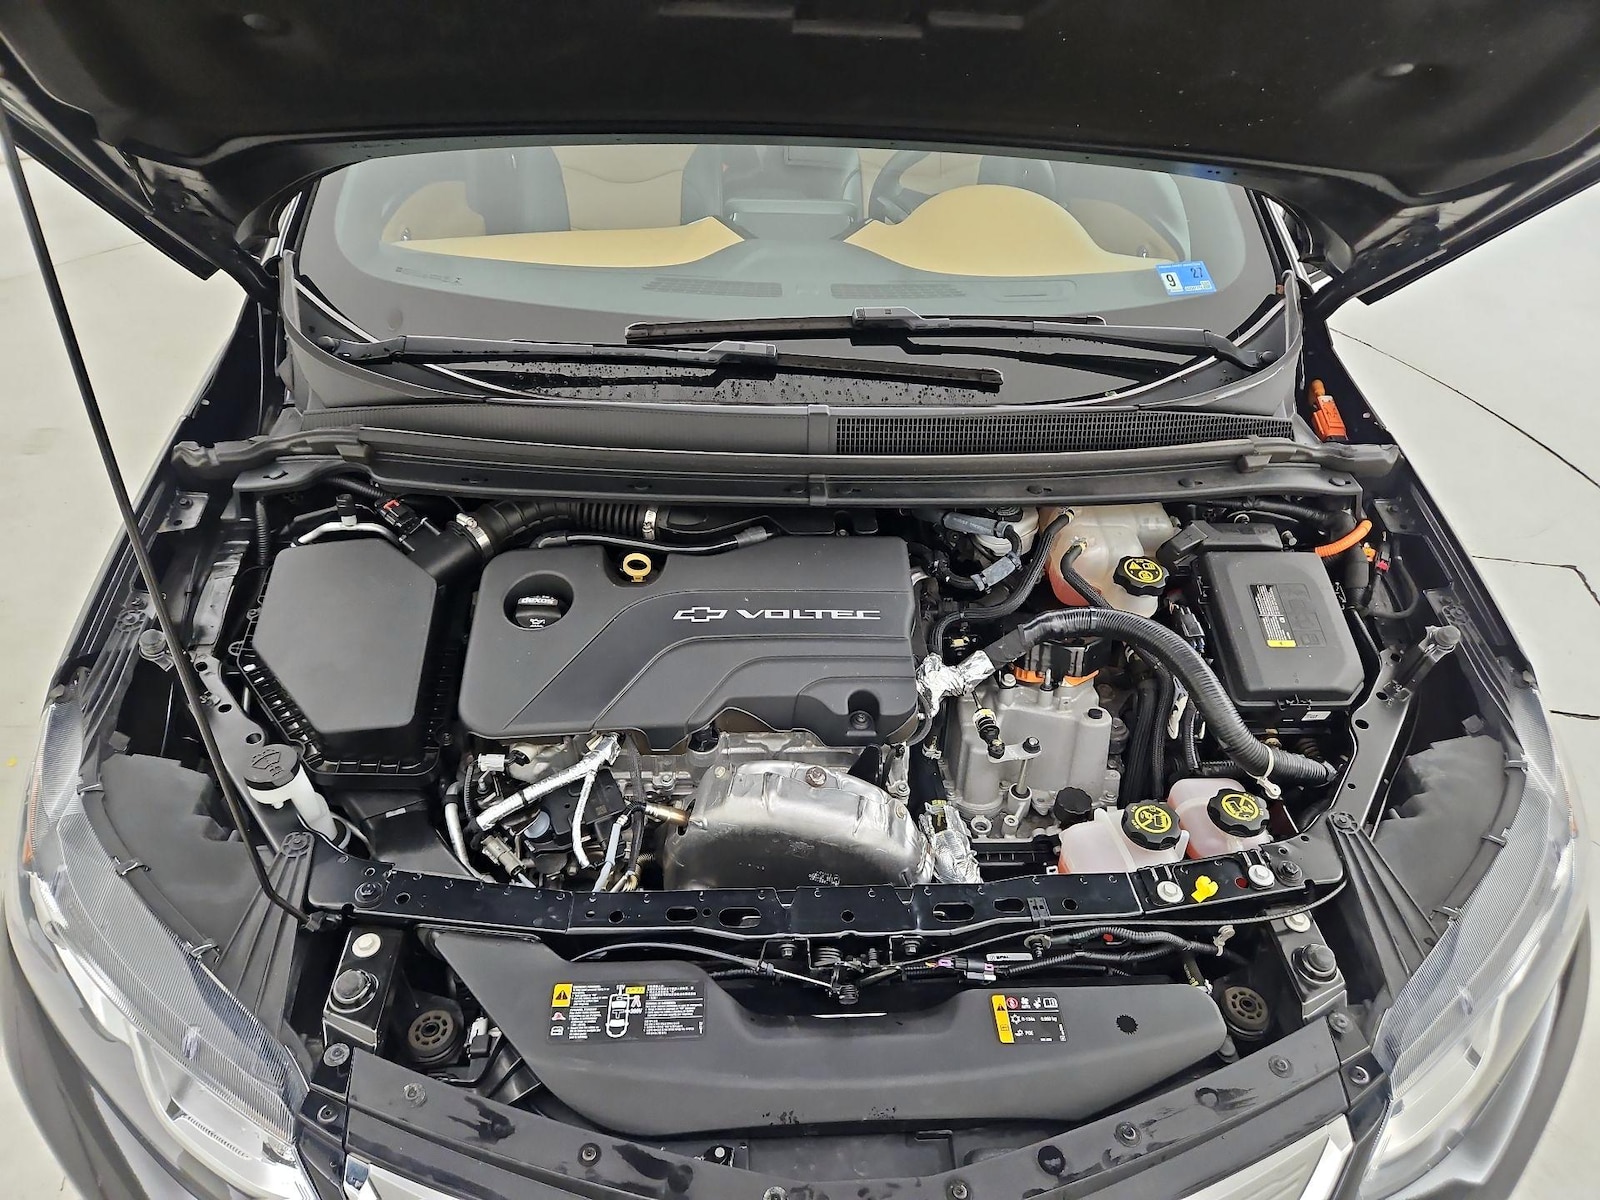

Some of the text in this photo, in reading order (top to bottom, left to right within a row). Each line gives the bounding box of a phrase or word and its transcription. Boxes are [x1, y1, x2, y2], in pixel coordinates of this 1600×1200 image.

[1190, 267, 1203, 278] 27
[1166, 274, 1176, 287] 9
[736, 609, 881, 620] VOLTEC
